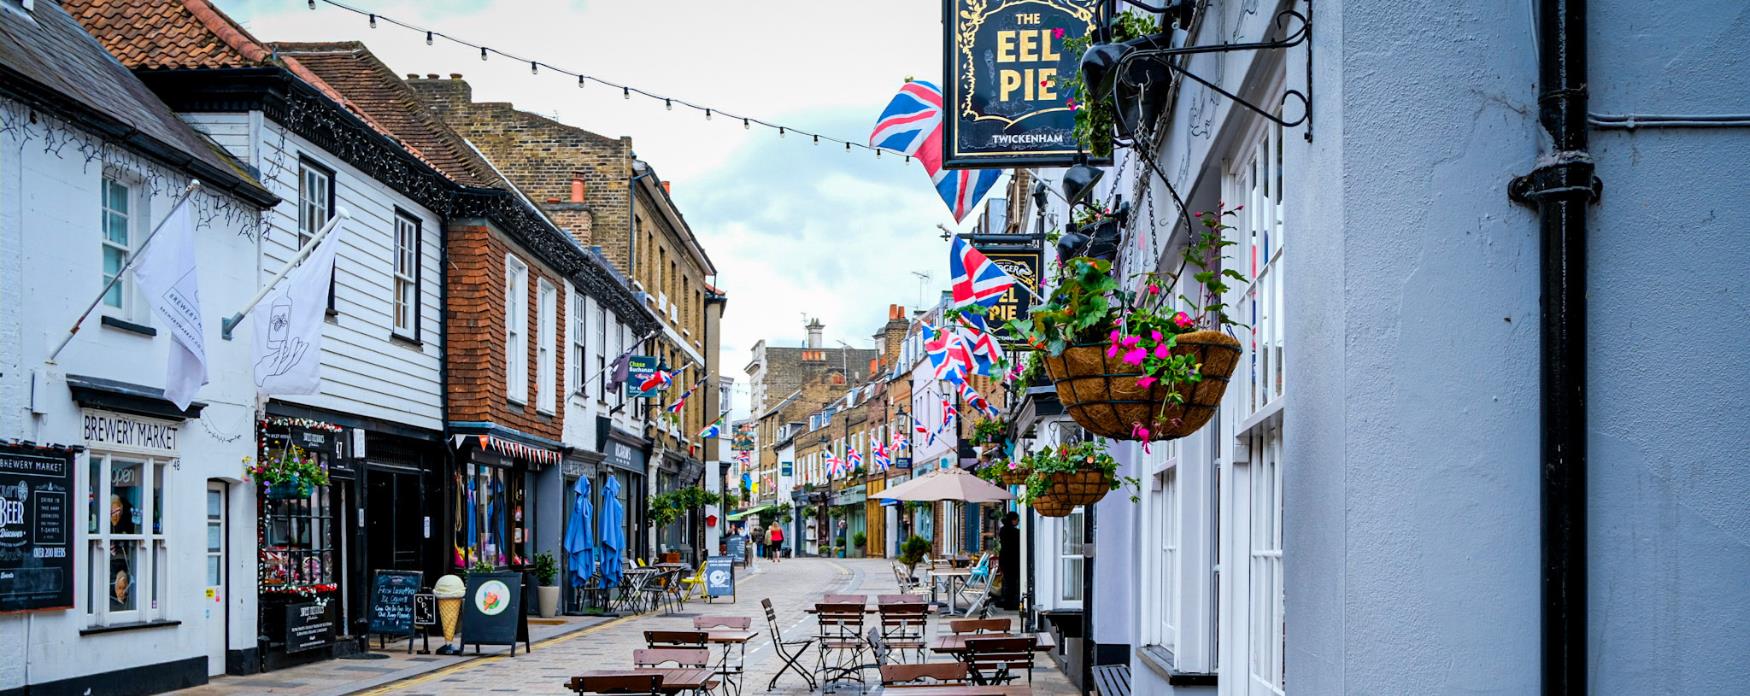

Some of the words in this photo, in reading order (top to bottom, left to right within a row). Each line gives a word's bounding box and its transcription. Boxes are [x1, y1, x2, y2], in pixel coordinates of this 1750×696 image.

[1015, 13, 1041, 25] THE
[996, 29, 1061, 63] EEL
[999, 67, 1057, 102] PIE
[992, 133, 1064, 144] TWICKENHAM
[168, 293, 198, 321] BREWERY
[989, 304, 1018, 321] PIE
[84, 415, 135, 445] BREWERY
[137, 422, 178, 450] MARKET
[0, 459, 34, 470] BREWERY
[35, 461, 62, 472] MARKET
[173, 459, 181, 471] 48
[111, 468, 136, 487] open
[0, 496, 25, 528] BEER
